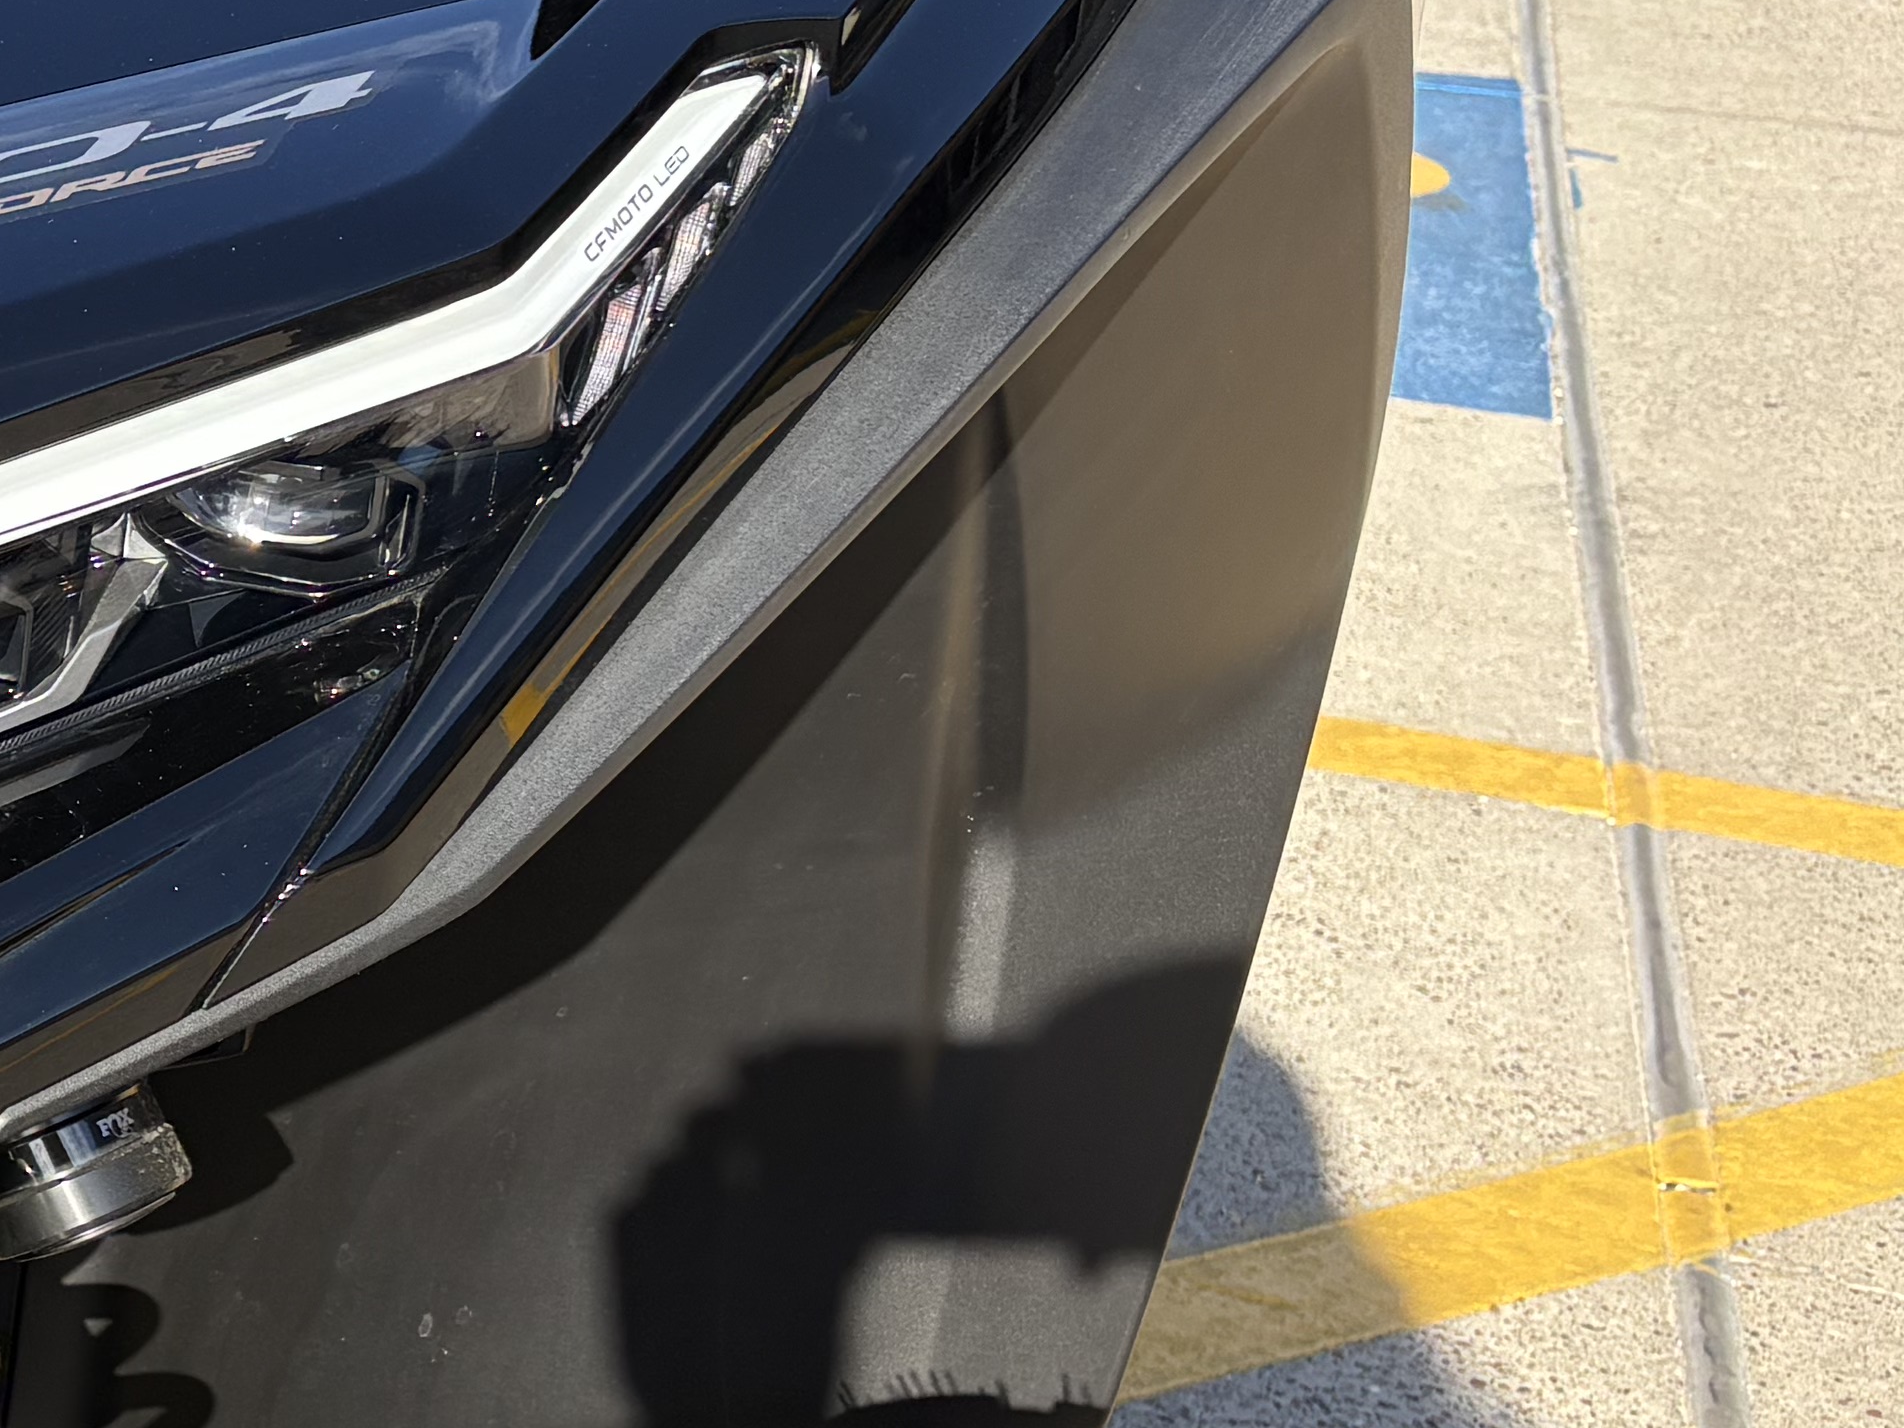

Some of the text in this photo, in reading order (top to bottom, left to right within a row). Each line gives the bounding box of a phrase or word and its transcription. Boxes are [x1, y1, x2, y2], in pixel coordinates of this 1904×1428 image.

[583, 145, 690, 262] CFMOTO LED
[96, 1107, 135, 1139] FOX
